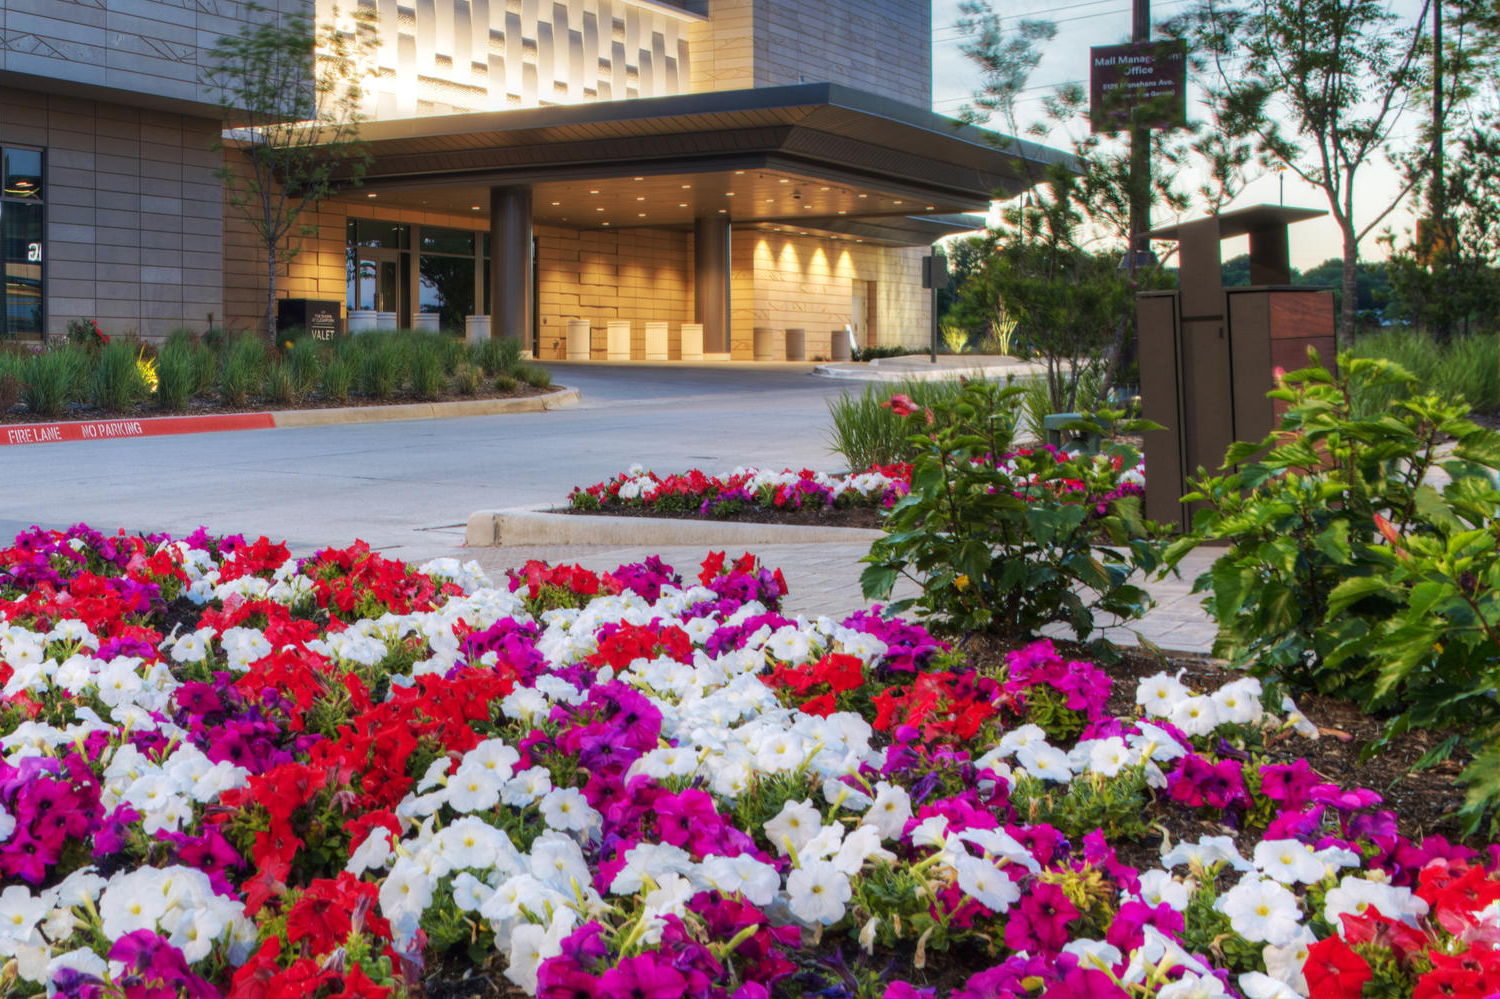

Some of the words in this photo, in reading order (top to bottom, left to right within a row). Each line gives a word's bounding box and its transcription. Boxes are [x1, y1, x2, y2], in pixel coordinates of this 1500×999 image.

[1094, 56, 1116, 67] Mall
[311, 329, 335, 341] VALET
[7, 428, 33, 444] FIRE
[34, 426, 62, 442] LANE
[81, 424, 98, 438] NO
[98, 422, 143, 437] PARKING
